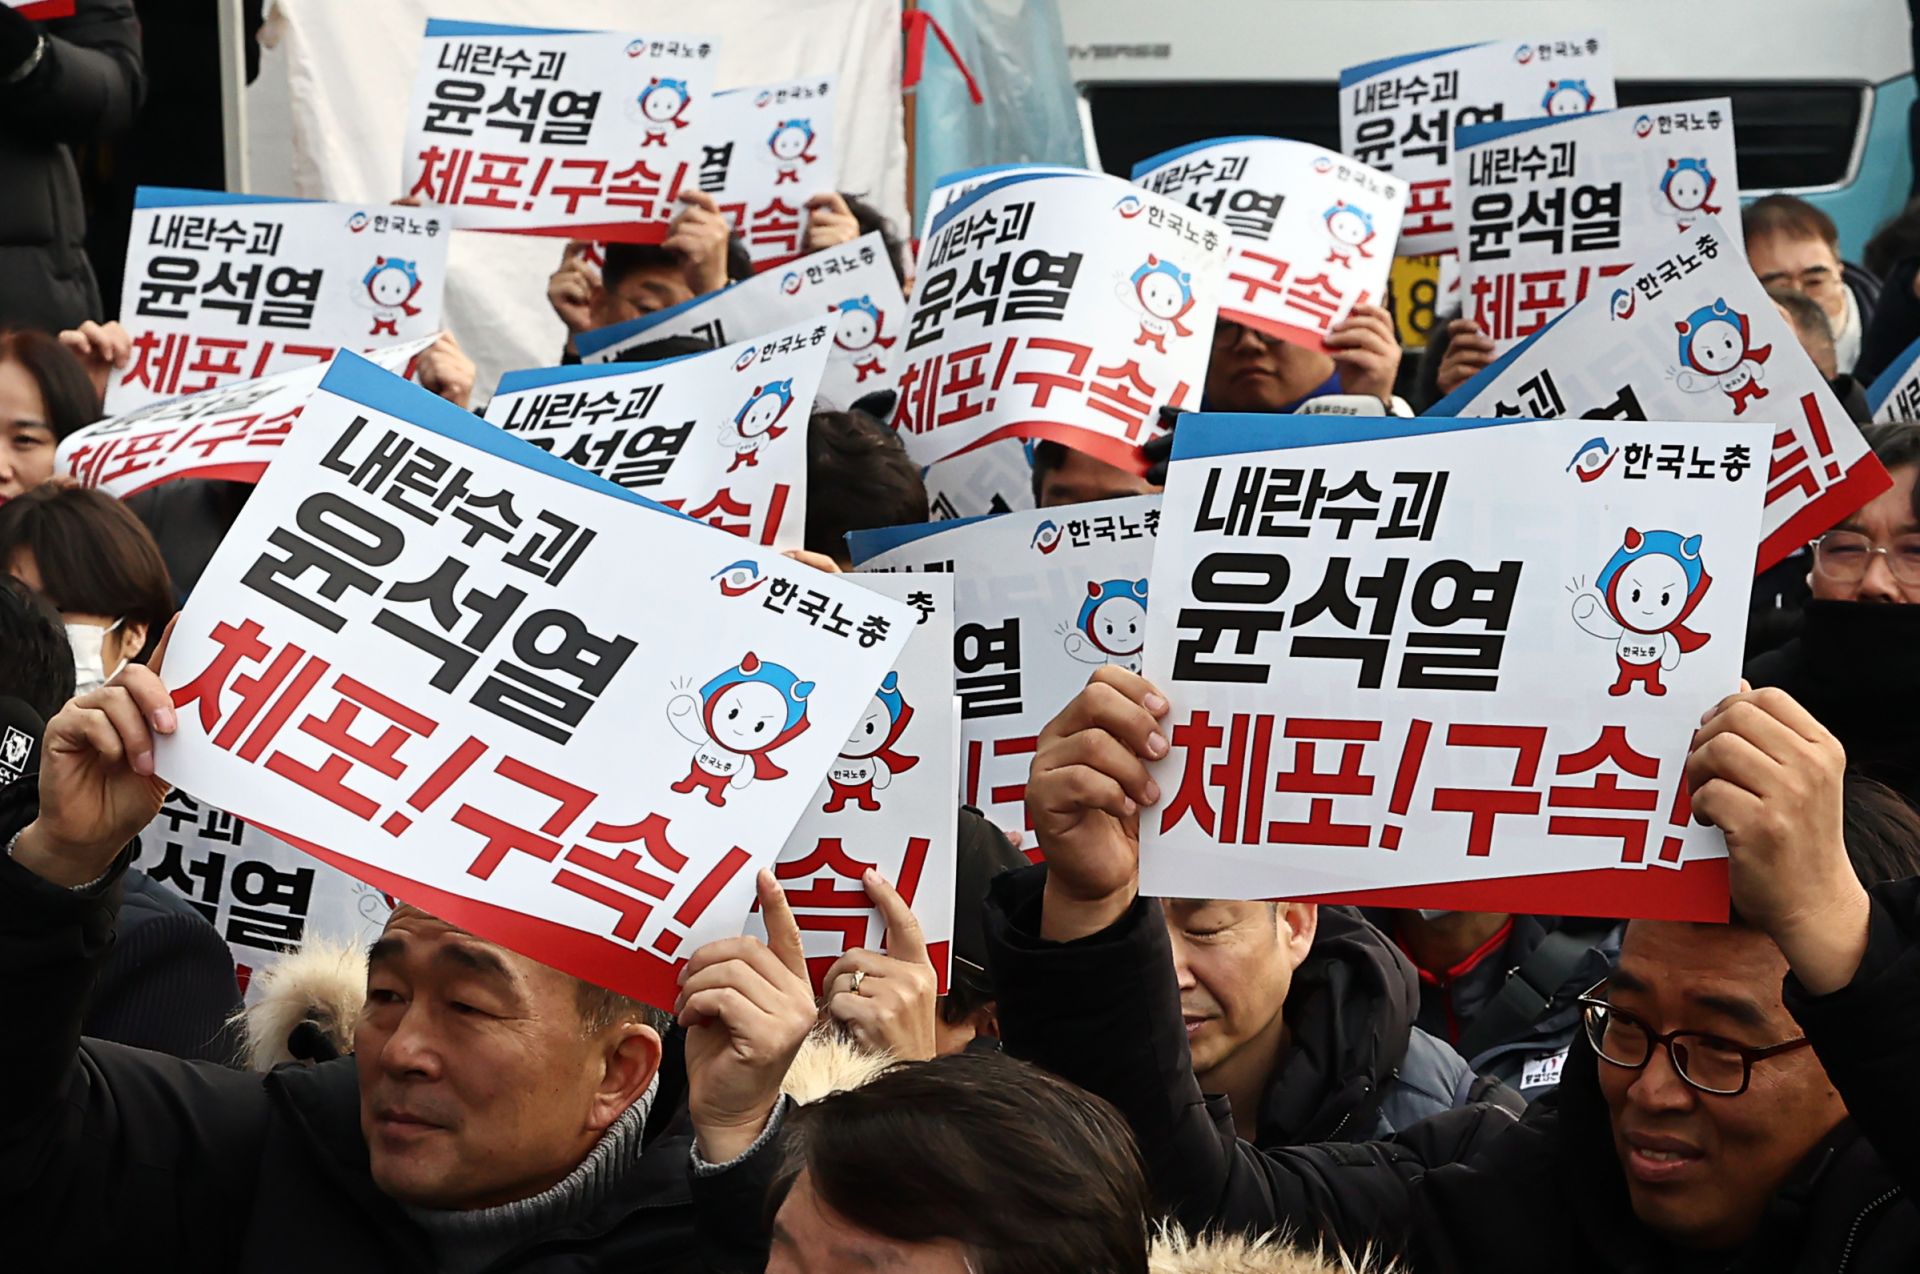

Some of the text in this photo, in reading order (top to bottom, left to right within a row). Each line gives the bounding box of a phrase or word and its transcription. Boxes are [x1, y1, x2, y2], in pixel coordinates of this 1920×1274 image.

[437, 43, 566, 81] 내란수괴
[650, 41, 712, 59] 한국노총
[1539, 39, 1599, 62] 한국노총
[422, 79, 602, 146] 윤석열
[1354, 70, 1459, 116] 내란수괴
[1658, 110, 1722, 136] 한국노총
[1140, 156, 1250, 195] 내란수괴
[1337, 163, 1397, 200] 한국노총
[1469, 141, 1576, 187] 내란수괴
[148, 214, 283, 256] 내란수괴
[374, 214, 441, 238] 한국노총
[926, 201, 1036, 272] 내란수괴
[1148, 204, 1219, 252] 한국노총
[1469, 182, 1622, 262] 윤석열
[806, 246, 875, 286] 한국노총
[1636, 234, 1721, 301] 한국노총
[136, 256, 324, 330] 윤석열
[904, 249, 1084, 352] 윤석열
[760, 325, 826, 364] 한국노총
[502, 383, 664, 431] 내란수괴
[67, 405, 305, 490] 체포!구속
[1622, 443, 1752, 482] 한국노총
[320, 416, 599, 589] 내란수괴
[1193, 466, 1450, 542] 내란수괴
[241, 491, 639, 746] 윤석열
[762, 575, 893, 650] 한국노총
[1171, 552, 1523, 692] 윤석열
[1623, 646, 1656, 657] 한국노총
[700, 754, 732, 772] 한국노총
[834, 769, 867, 780] 한국노총
